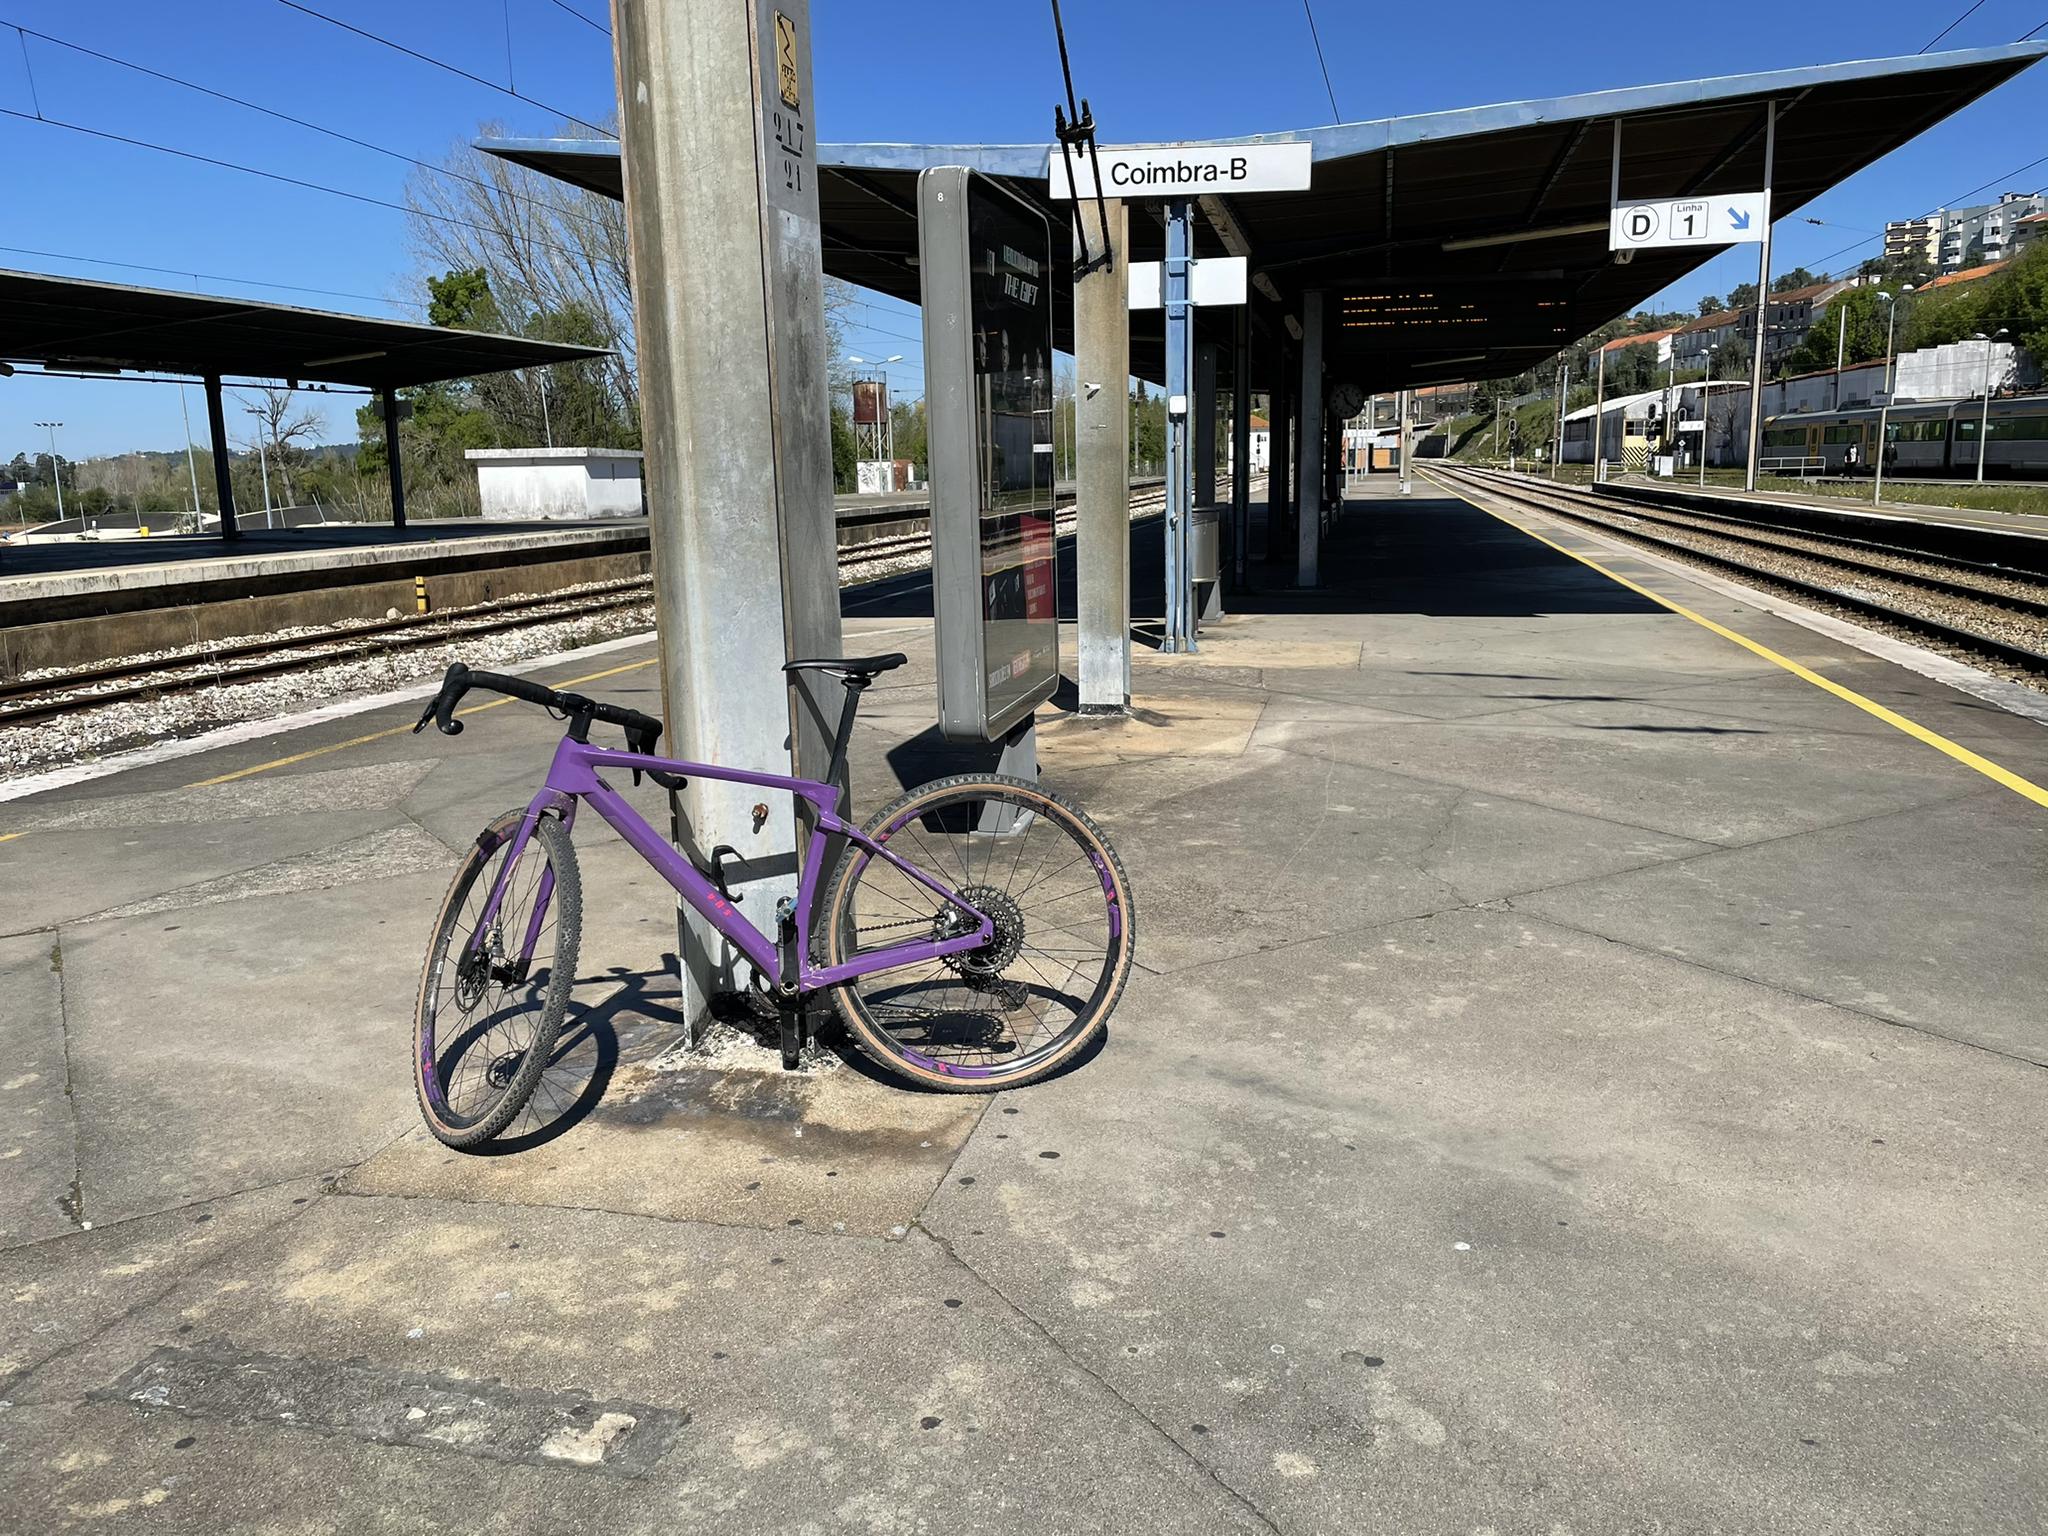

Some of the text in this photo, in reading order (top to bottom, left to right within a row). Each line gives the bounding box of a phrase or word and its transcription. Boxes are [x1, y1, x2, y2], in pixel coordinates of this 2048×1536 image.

[1111, 157, 1247, 186] Coimbra-B
[937, 192, 944, 202] 8
[1677, 204, 1702, 213] Linha
[1631, 214, 1651, 236] D
[1683, 214, 1694, 236] 1
[1004, 272, 1039, 306] THE GIFT
